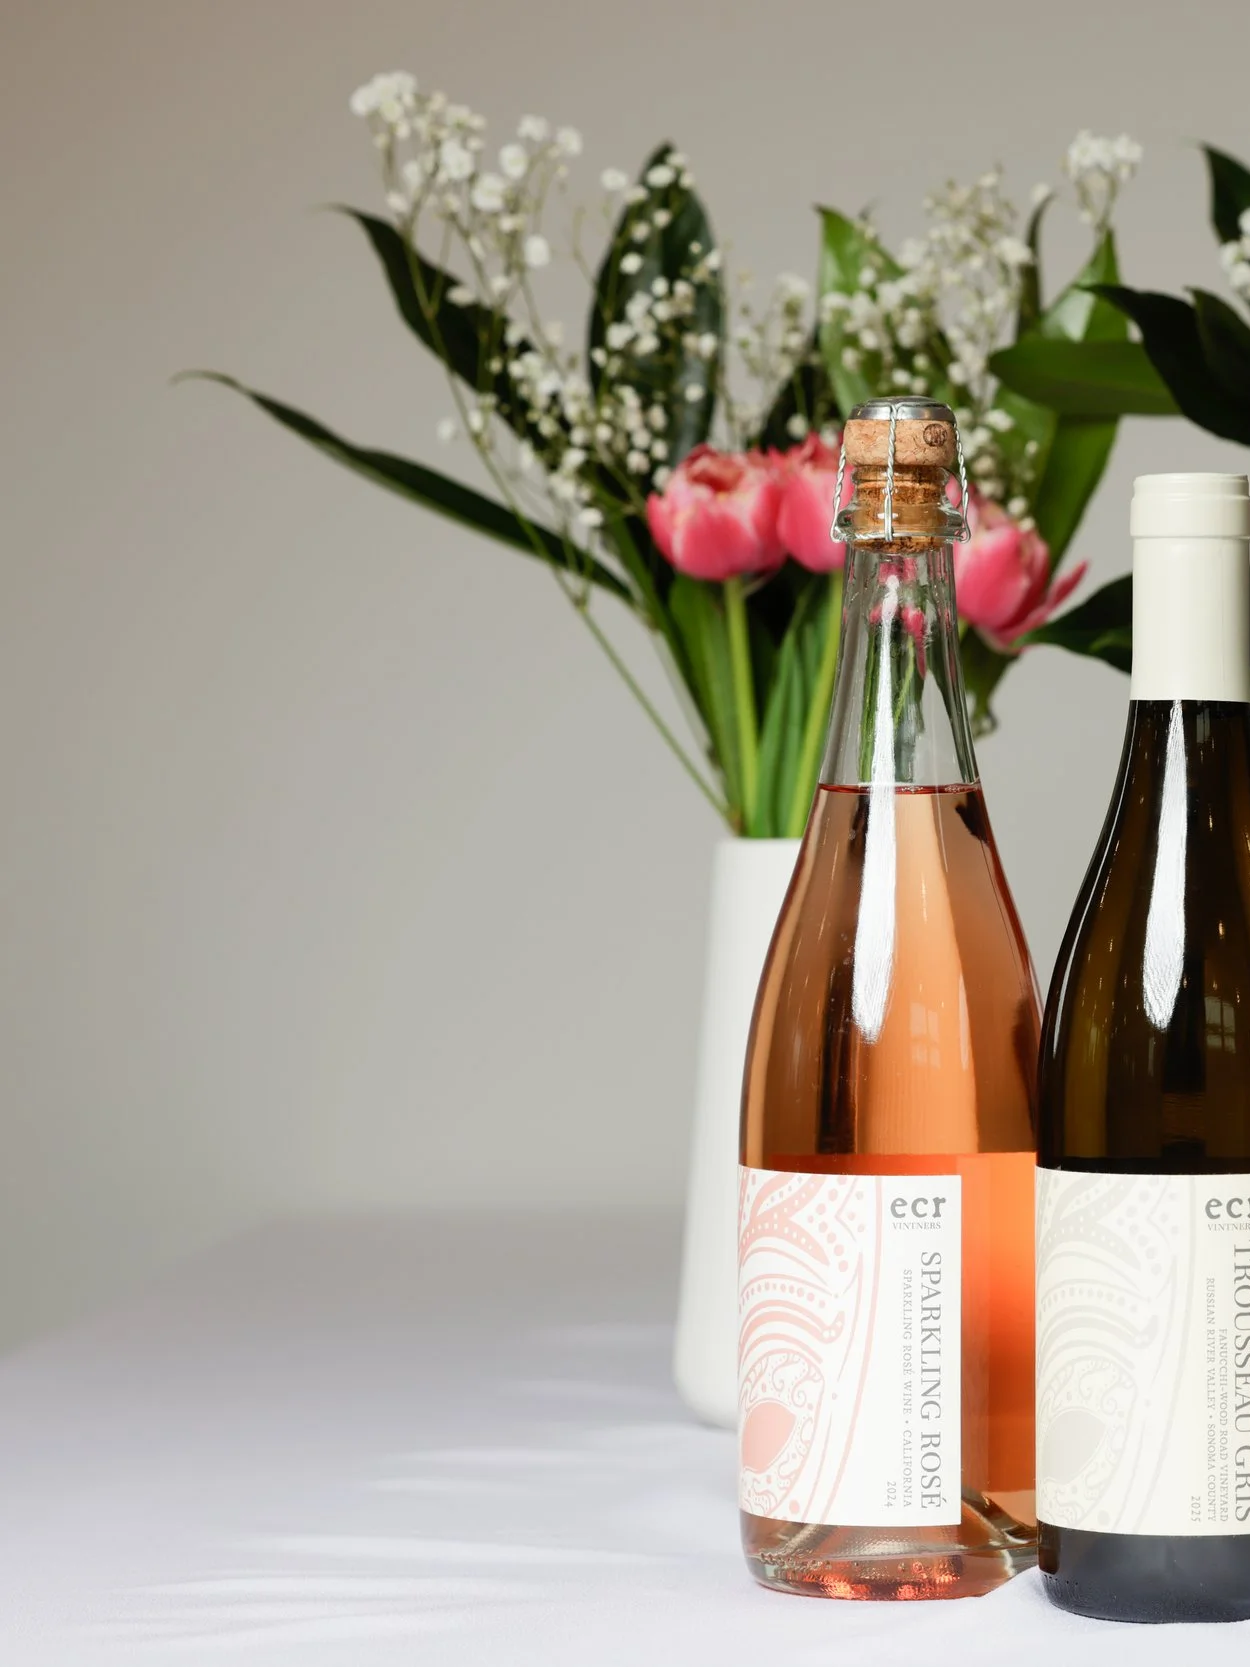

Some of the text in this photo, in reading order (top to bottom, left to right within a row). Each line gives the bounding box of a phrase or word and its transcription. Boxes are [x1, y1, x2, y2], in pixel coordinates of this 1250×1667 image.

[890, 1197, 946, 1218] ecr
[891, 1220, 942, 1231] VINTNERS
[902, 1268, 916, 1508] SPARKLING ROSÉ WINE CALIFORNIA
[921, 1252, 947, 1508] SPARKLING ROSÉ
[1205, 1277, 1217, 1522] RUSSIAN RIVER VALLEY SONOMA COUNTY
[1218, 1327, 1229, 1523] FANUCCHI-WOOD ROAD VINEYARD
[883, 1480, 897, 1509] 2024
[1190, 1495, 1202, 1523] 2025
